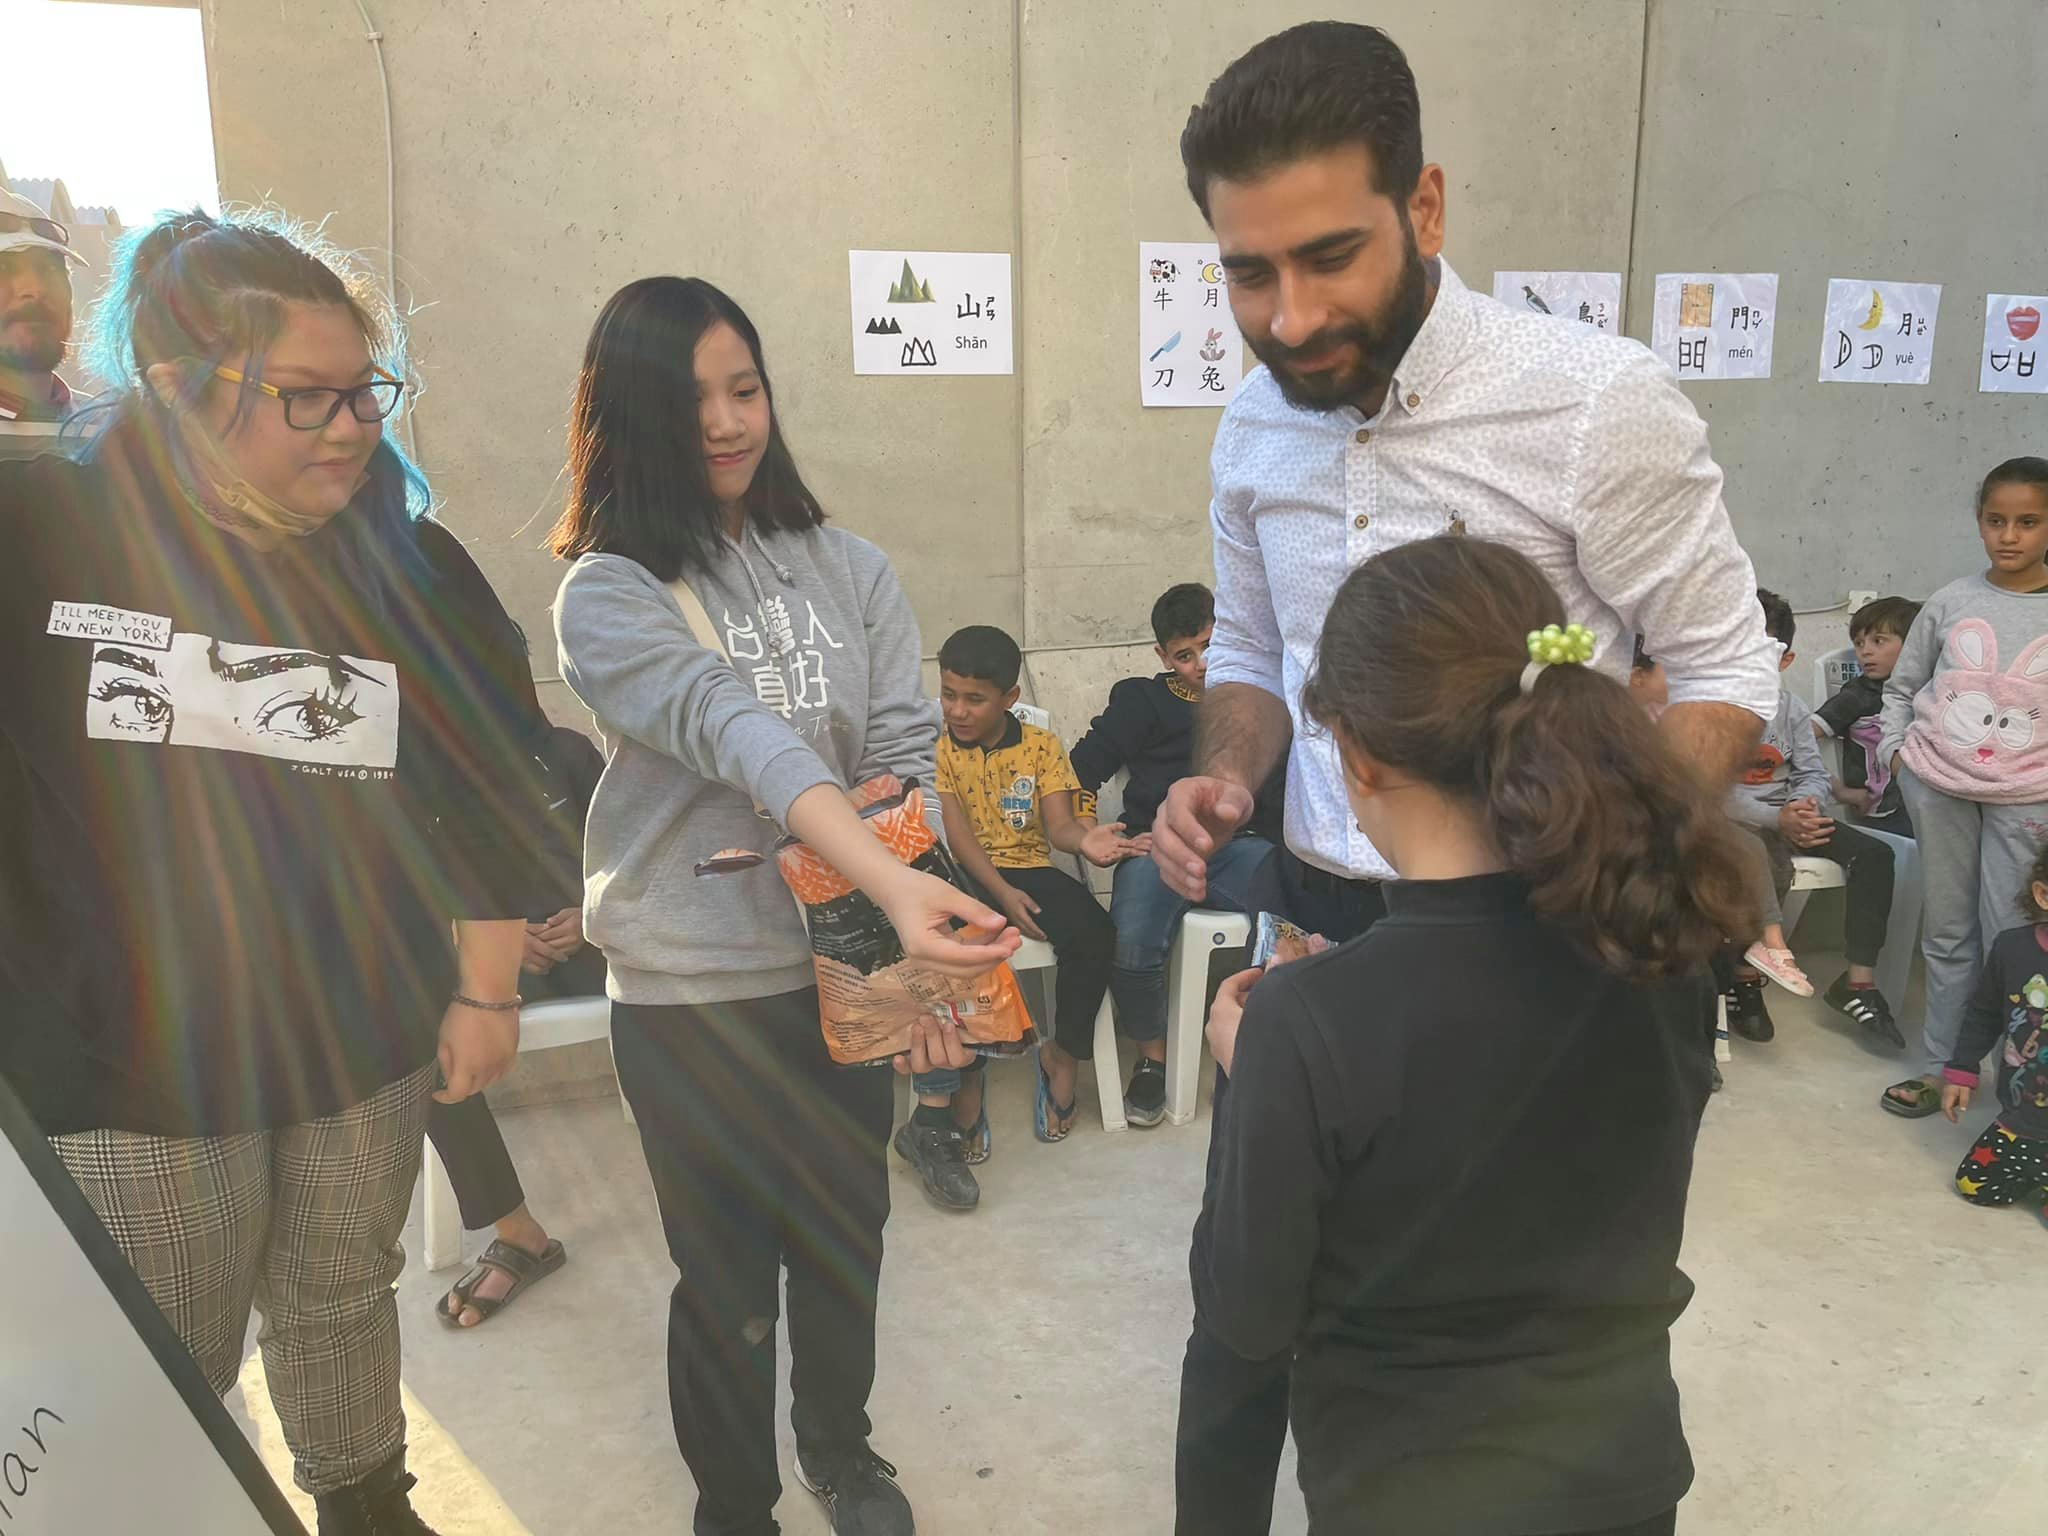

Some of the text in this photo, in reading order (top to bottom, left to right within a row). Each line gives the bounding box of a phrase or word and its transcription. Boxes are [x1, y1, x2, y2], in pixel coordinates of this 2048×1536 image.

[957, 292, 981, 319] 山
[1153, 287, 1218, 311] 牛 月
[1579, 301, 1594, 324] 鳥
[1730, 305, 1750, 331] 門
[1897, 312, 1913, 336] 月
[955, 335, 988, 350] Shān
[1728, 345, 1753, 359] mén
[1895, 351, 1915, 366] yuè
[1151, 365, 1226, 393] 刀 兔
[52, 620, 71, 632] IN
[77, 622, 113, 636] NEW
[88, 604, 124, 622] MEET
[131, 616, 161, 631] YOU
[302, 765, 332, 776] GALT
